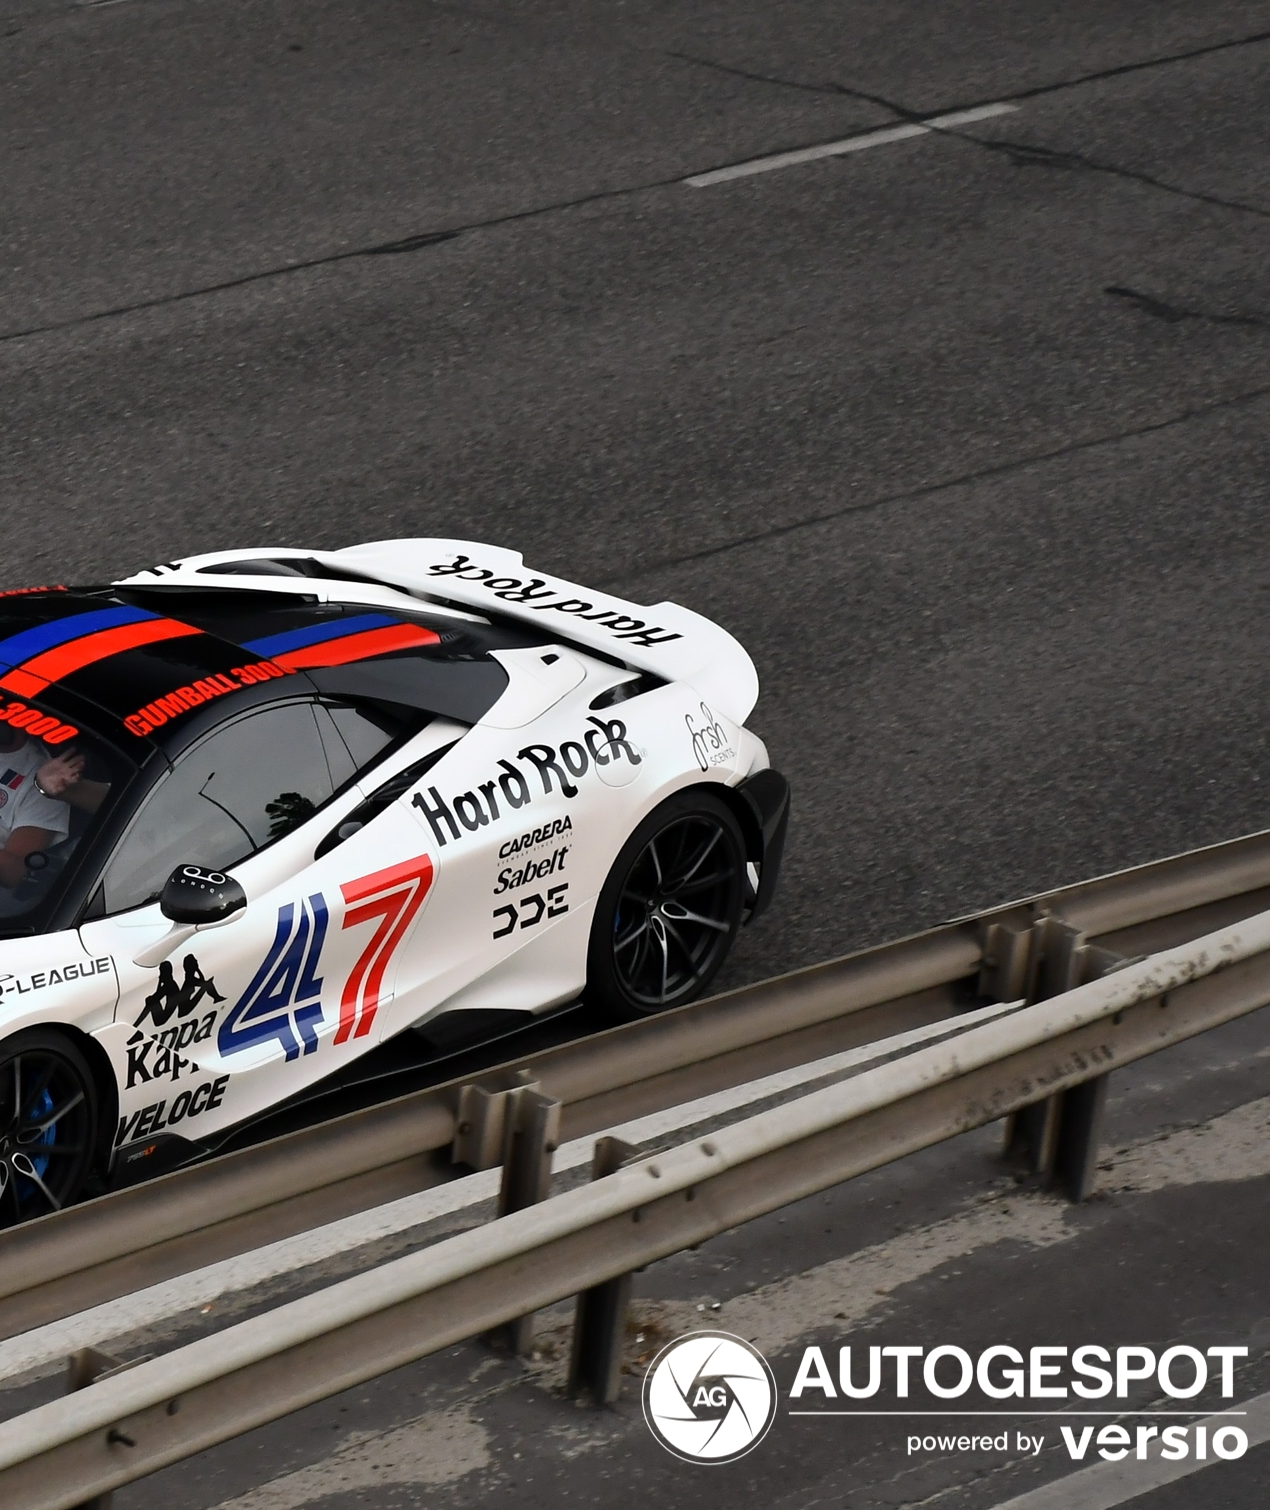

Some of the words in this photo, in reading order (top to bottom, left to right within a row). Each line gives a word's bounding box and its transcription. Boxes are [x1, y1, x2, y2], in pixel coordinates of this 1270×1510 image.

[427, 555, 557, 609] Rock
[560, 599, 684, 647] Hard
[123, 673, 242, 737] GUMBALL
[411, 760, 531, 847] Hard
[517, 716, 642, 798] Rock
[710, 747, 735, 766] SCENTS
[498, 815, 573, 859] CARRERA
[493, 846, 569, 894] Sabelt
[216, 853, 434, 1063] 47
[115, 1073, 230, 1147] VELOCE
